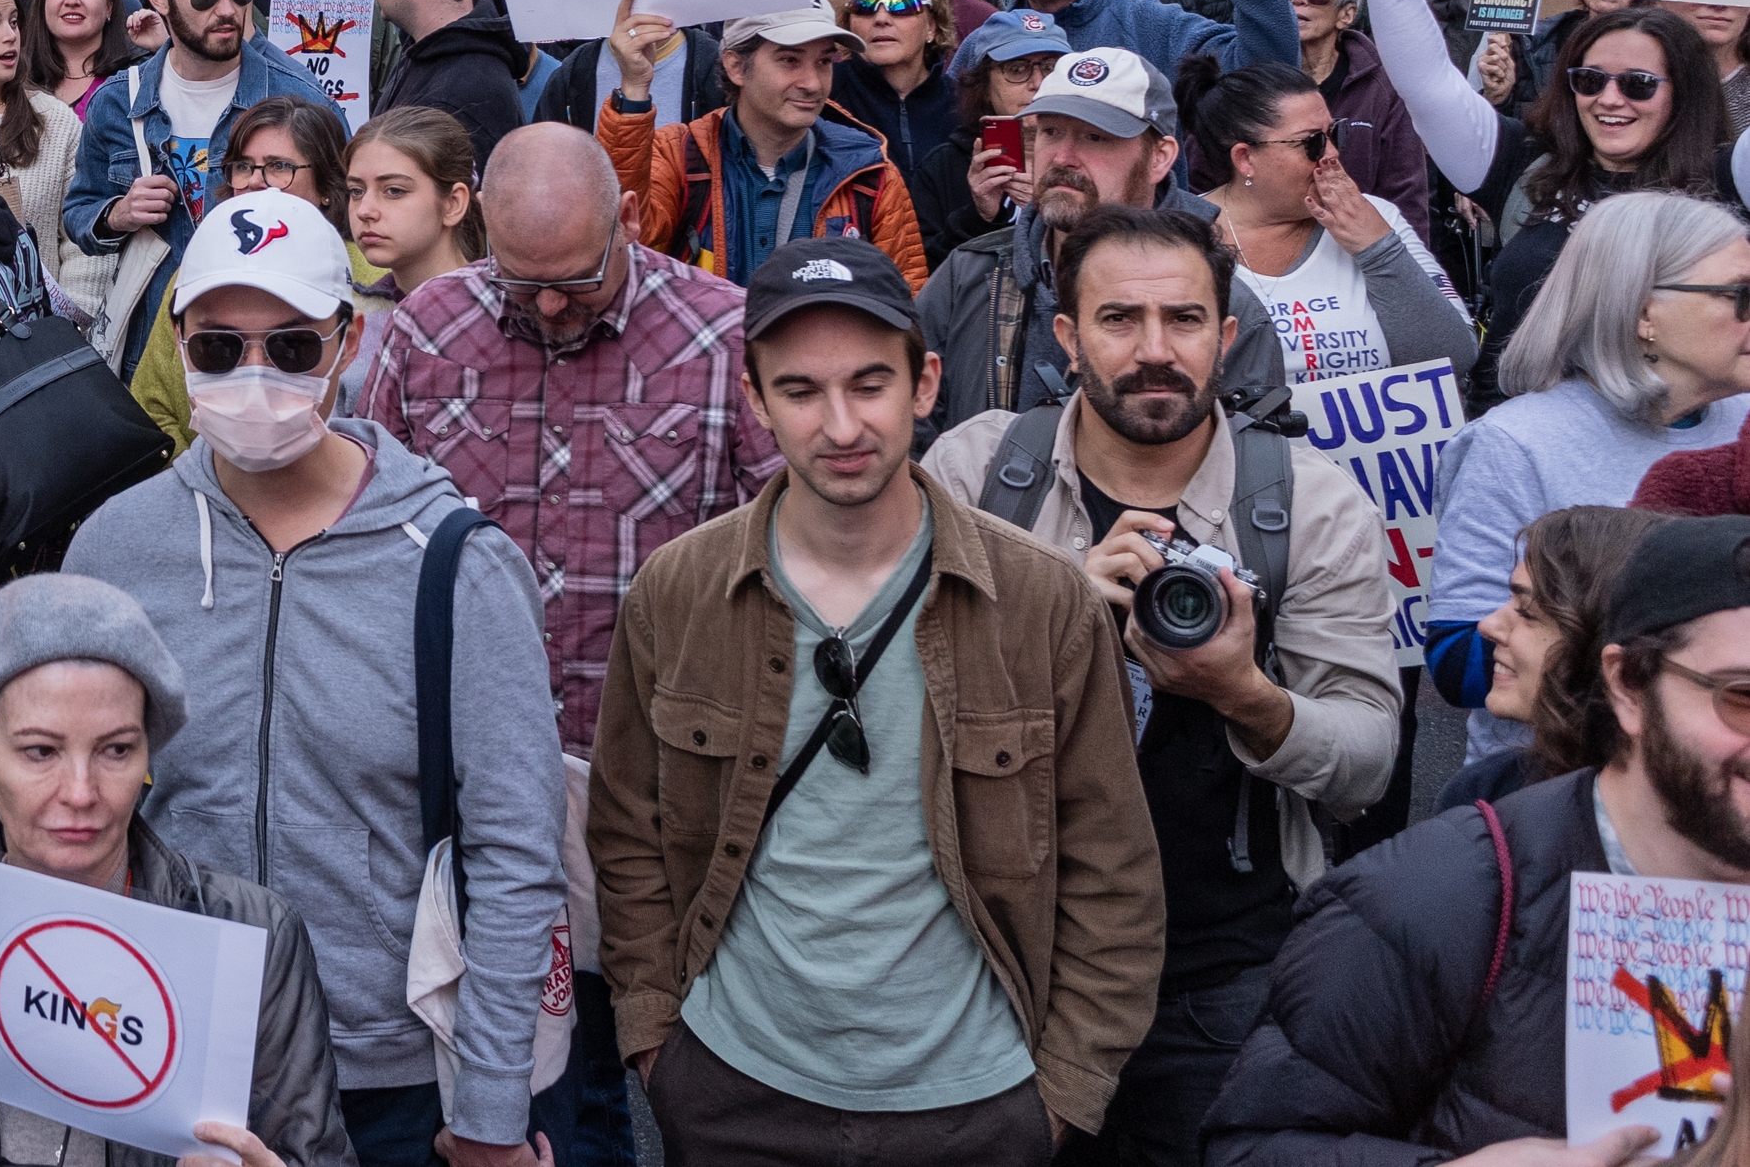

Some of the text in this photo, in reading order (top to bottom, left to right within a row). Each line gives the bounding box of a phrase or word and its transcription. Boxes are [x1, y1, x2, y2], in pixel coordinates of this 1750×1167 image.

[1478, 7, 1524, 20] IS IN DANGER
[792, 265, 830, 279] NORTH
[803, 272, 830, 282] FACE
[1307, 365, 1452, 450] JUST
[23, 984, 144, 1046] KINGS
